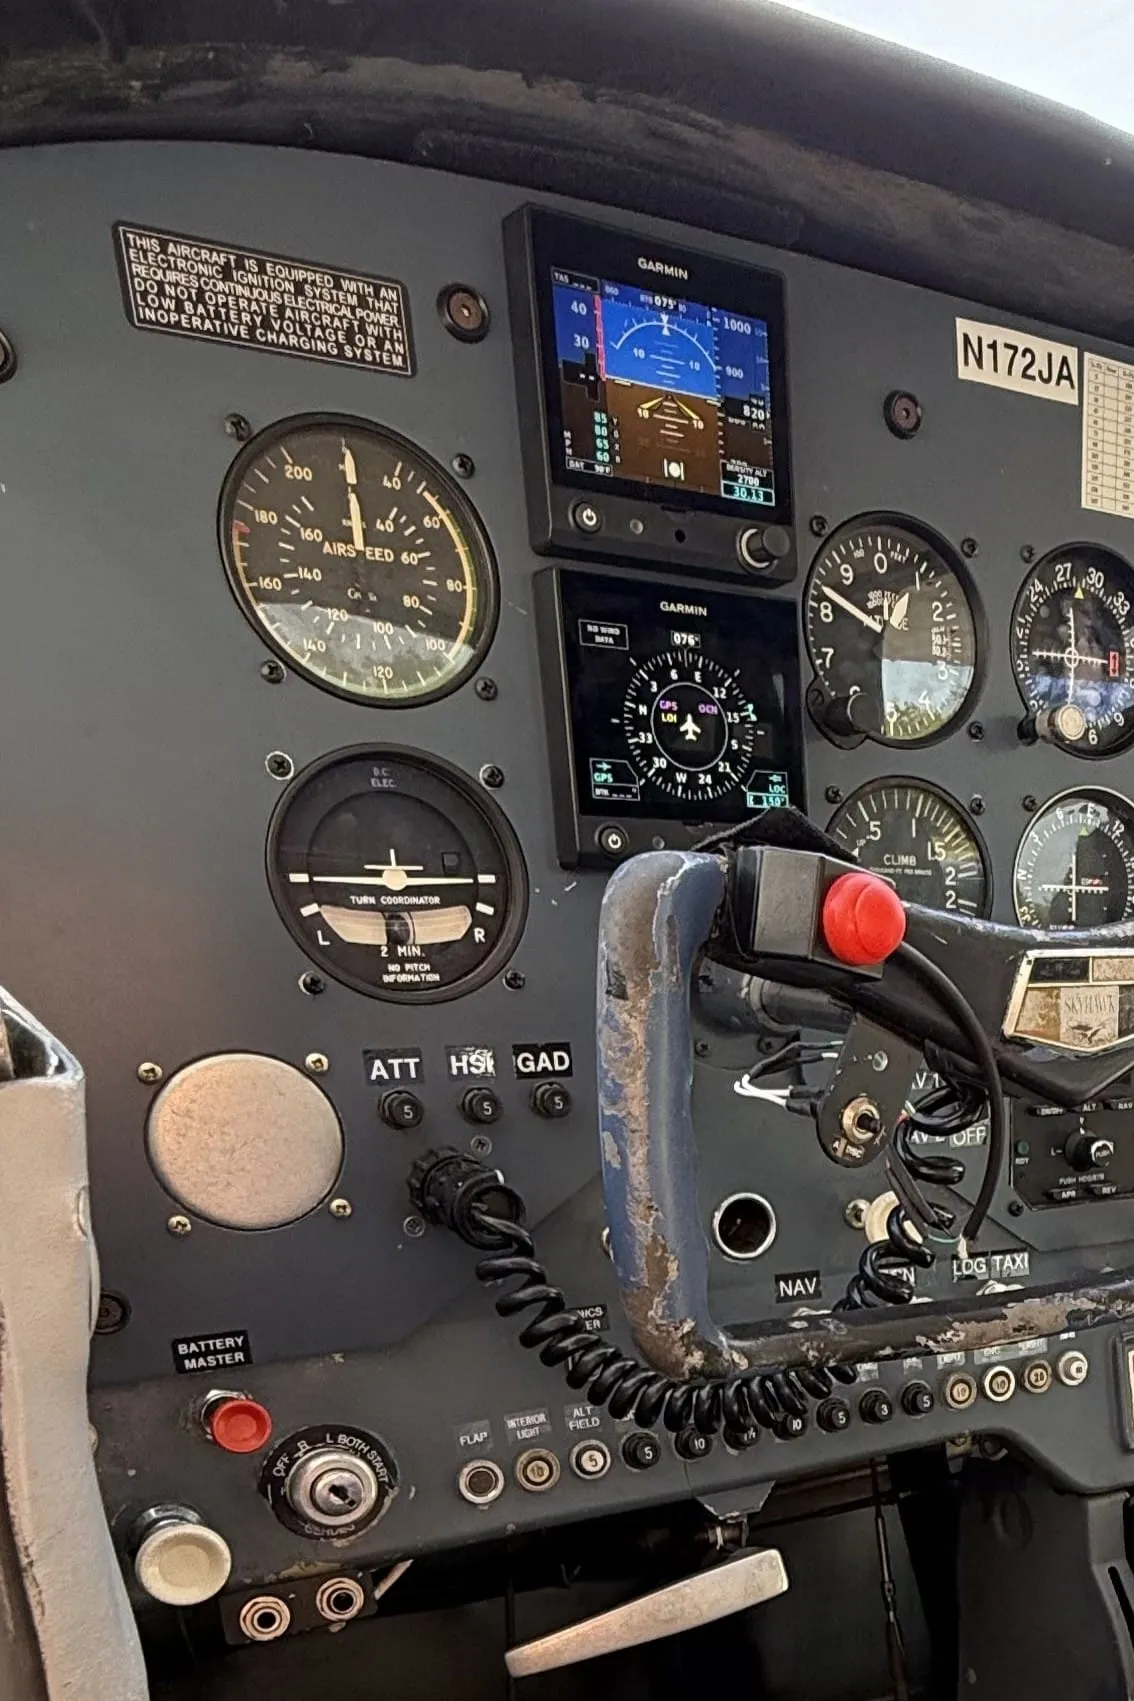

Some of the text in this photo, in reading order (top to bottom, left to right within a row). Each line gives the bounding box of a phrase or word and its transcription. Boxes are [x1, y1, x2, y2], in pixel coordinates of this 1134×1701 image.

[127, 233, 397, 300] THIS AIRCRAFT IS EQUIPPED WITH AN
[637, 257, 688, 280] GARMIN
[129, 248, 398, 314] ELECTRONIC IGNITION SYSTEM THAT
[131, 263, 198, 287] REQUIRES
[201, 277, 282, 304] CONTINUOUS
[284, 293, 355, 319] ELECTRICAL
[134, 278, 402, 341] DO NOT OPERATE AIRCRAFT WITH
[571, 301, 587, 315] 40
[136, 292, 404, 354] LOW BATTERY VOLTAGE OR AN
[723, 317, 751, 335] 1000
[139, 307, 249, 339] INOPERATIVE
[256, 329, 338, 354] CHARGING
[573, 334, 589, 349] 30
[633, 347, 645, 359] 10
[962, 332, 1075, 390] N172JA
[726, 366, 744, 379] 900
[637, 408, 649, 419] 10
[744, 406, 766, 421] 820
[285, 464, 312, 481] 200
[383, 476, 401, 490] 40
[254, 511, 277, 525] 180
[423, 517, 440, 529] 60
[376, 519, 394, 533] 40
[300, 528, 322, 541] 160
[323, 537, 394, 561] AIRSEED
[401, 553, 418, 565] 60
[874, 553, 887, 574] 0
[299, 568, 322, 581] 140
[840, 564, 854, 585] 9
[1054, 563, 1072, 582] 27
[1086, 567, 1104, 588] 30
[259, 577, 282, 590] 160
[447, 579, 462, 592] 80
[1028, 579, 1044, 603] 24
[403, 596, 419, 608] 80
[660, 601, 707, 616] GARMIN
[1113, 592, 1131, 616] 33
[327, 608, 349, 621] 120
[820, 602, 833, 623] 8
[932, 601, 944, 622] 2
[373, 623, 394, 635] 100
[303, 640, 326, 652] 140
[426, 639, 445, 650] 100
[821, 648, 834, 668] 7
[373, 666, 393, 679] 120
[670, 669, 678, 680] 6
[694, 671, 702, 683] E
[937, 661, 948, 680] 3
[650, 681, 658, 693] 3
[713, 687, 727, 699] 12
[639, 704, 647, 716] N
[659, 700, 678, 711] GPS
[727, 712, 740, 723] 15
[638, 733, 652, 743] 33
[731, 739, 738, 749] S
[653, 758, 666, 768] 30
[718, 762, 730, 772] 21
[594, 773, 613, 783] GPS
[676, 773, 687, 783] W
[699, 774, 712, 784] 24
[1088, 803, 1098, 817] E
[1112, 820, 1124, 834] 12
[883, 854, 916, 866] CLIMB
[945, 866, 956, 885] 2
[350, 896, 440, 905] TURN COORDINATOR
[945, 890, 957, 909] 2
[317, 930, 330, 945] L
[474, 928, 486, 943] R
[380, 945, 426, 957] 2 MIN.
[388, 963, 430, 972] NO PITCH
[382, 973, 440, 983] INFORMATION
[517, 1051, 570, 1073] GAD
[370, 1058, 420, 1080] ATT
[483, 1102, 492, 1115] 5
[554, 1097, 563, 1109] 5
[1083, 1103, 1097, 1112] ALT
[403, 1105, 413, 1118] 5
[953, 1126, 987, 1145] OFF
[952, 1258, 987, 1276] LDG
[992, 1252, 1029, 1271] TAXI
[779, 1277, 817, 1298] NAV
[178, 1335, 245, 1355] BATTERY
[184, 1351, 245, 1370] MASTER
[923, 1395, 930, 1407] 5
[573, 1406, 592, 1417] ALT
[881, 1404, 888, 1416] 3
[507, 1413, 546, 1429] INTERIOR
[569, 1417, 600, 1431] FIELD
[839, 1411, 846, 1424] 5
[791, 1419, 802, 1430] 10
[326, 1433, 334, 1444] L
[459, 1431, 488, 1446] FLAP
[517, 1427, 541, 1440] LIGHT
[338, 1434, 371, 1454] BOTH
[694, 1438, 705, 1449] 10
[644, 1446, 653, 1459] 5
[272, 1453, 290, 1477] OFF
[367, 1450, 389, 1482] START
[589, 1456, 599, 1468] 5
